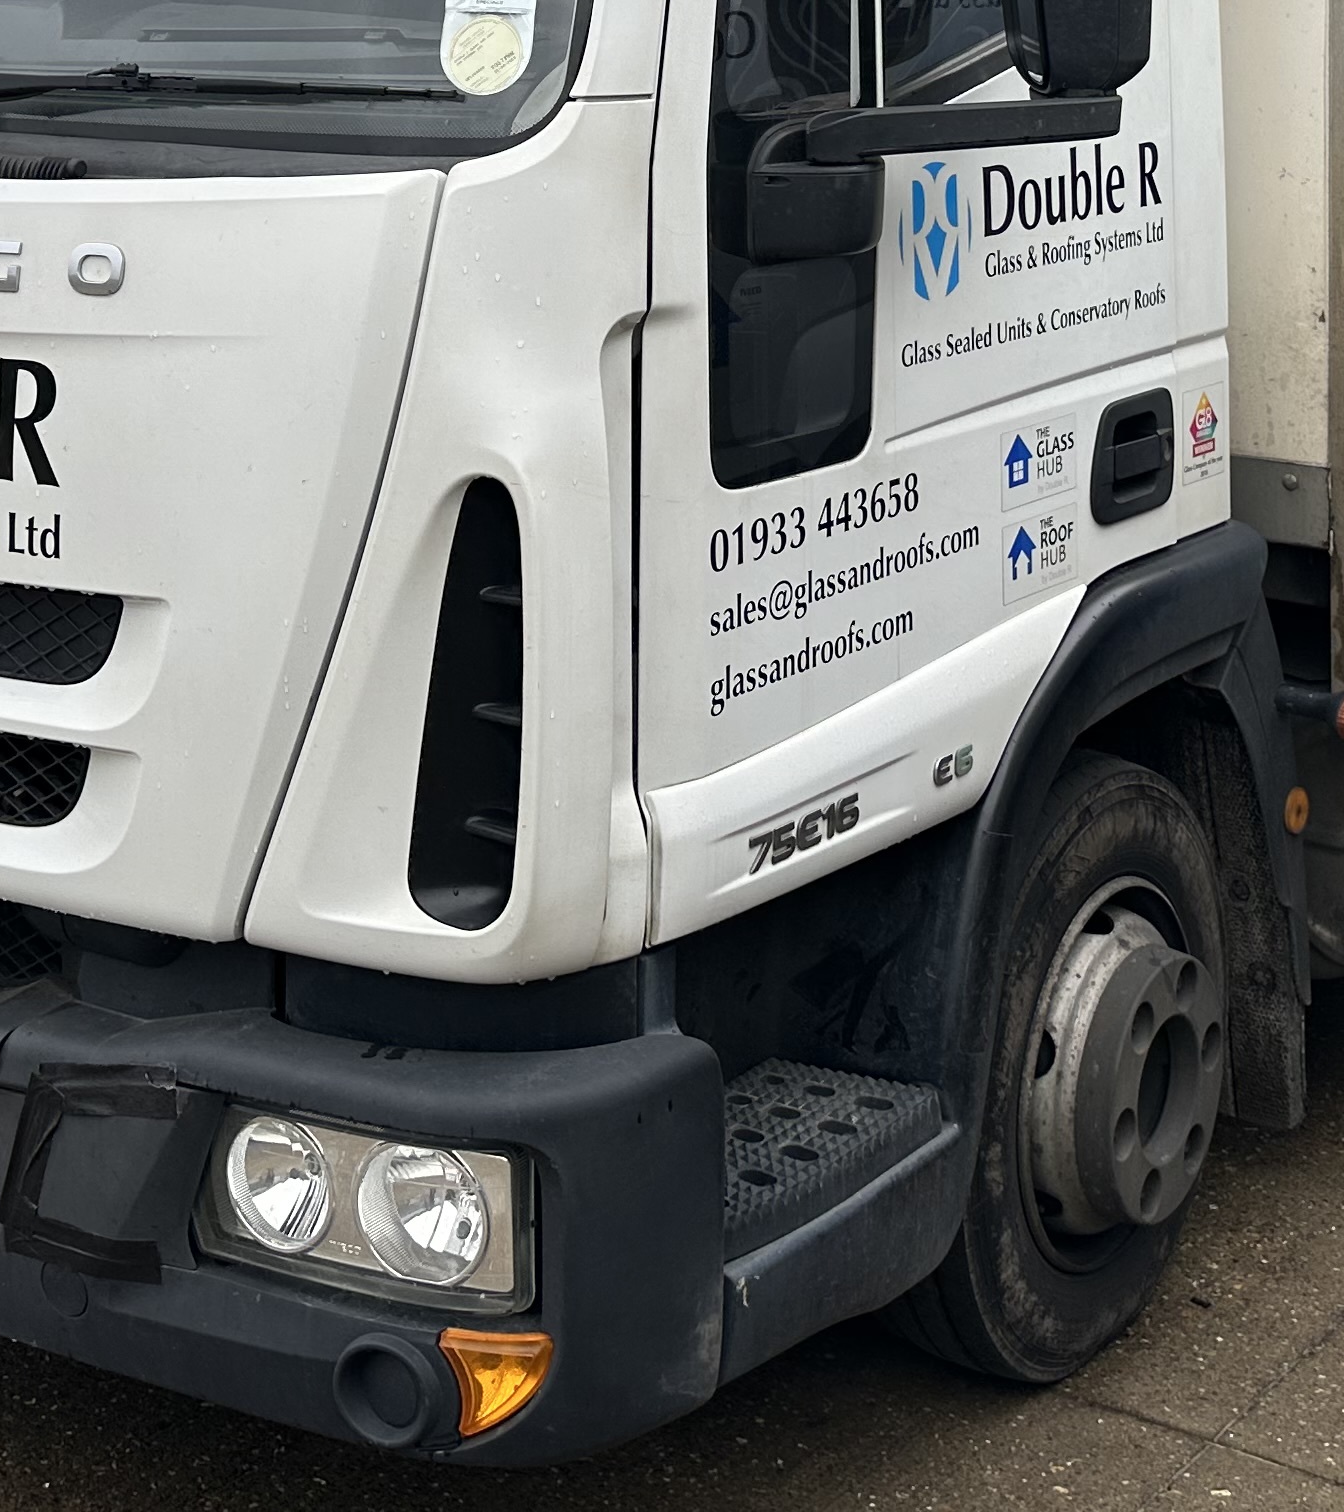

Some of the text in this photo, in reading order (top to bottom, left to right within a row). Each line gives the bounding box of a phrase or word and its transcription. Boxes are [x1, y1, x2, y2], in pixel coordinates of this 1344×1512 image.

[982, 141, 1162, 238] Double R
[985, 216, 1164, 278] Glass & Roofing Systems Ltd
[901, 282, 1167, 368] Glass Sealed Units & Conservatory Roofs
[1036, 426, 1051, 439] THE
[1036, 431, 1075, 458] GLASS
[1037, 454, 1063, 479] HUB
[8, 511, 61, 559] Ltd
[710, 472, 919, 572] 01933 443658
[1040, 516, 1054, 530] THE
[1040, 521, 1074, 550] ROOF
[710, 525, 980, 637] sales@glassandroofs.com
[1040, 544, 1066, 570] HUB
[710, 609, 914, 717] glassandroofs.com
[933, 744, 973, 786] E6
[749, 792, 859, 875] 75E16
